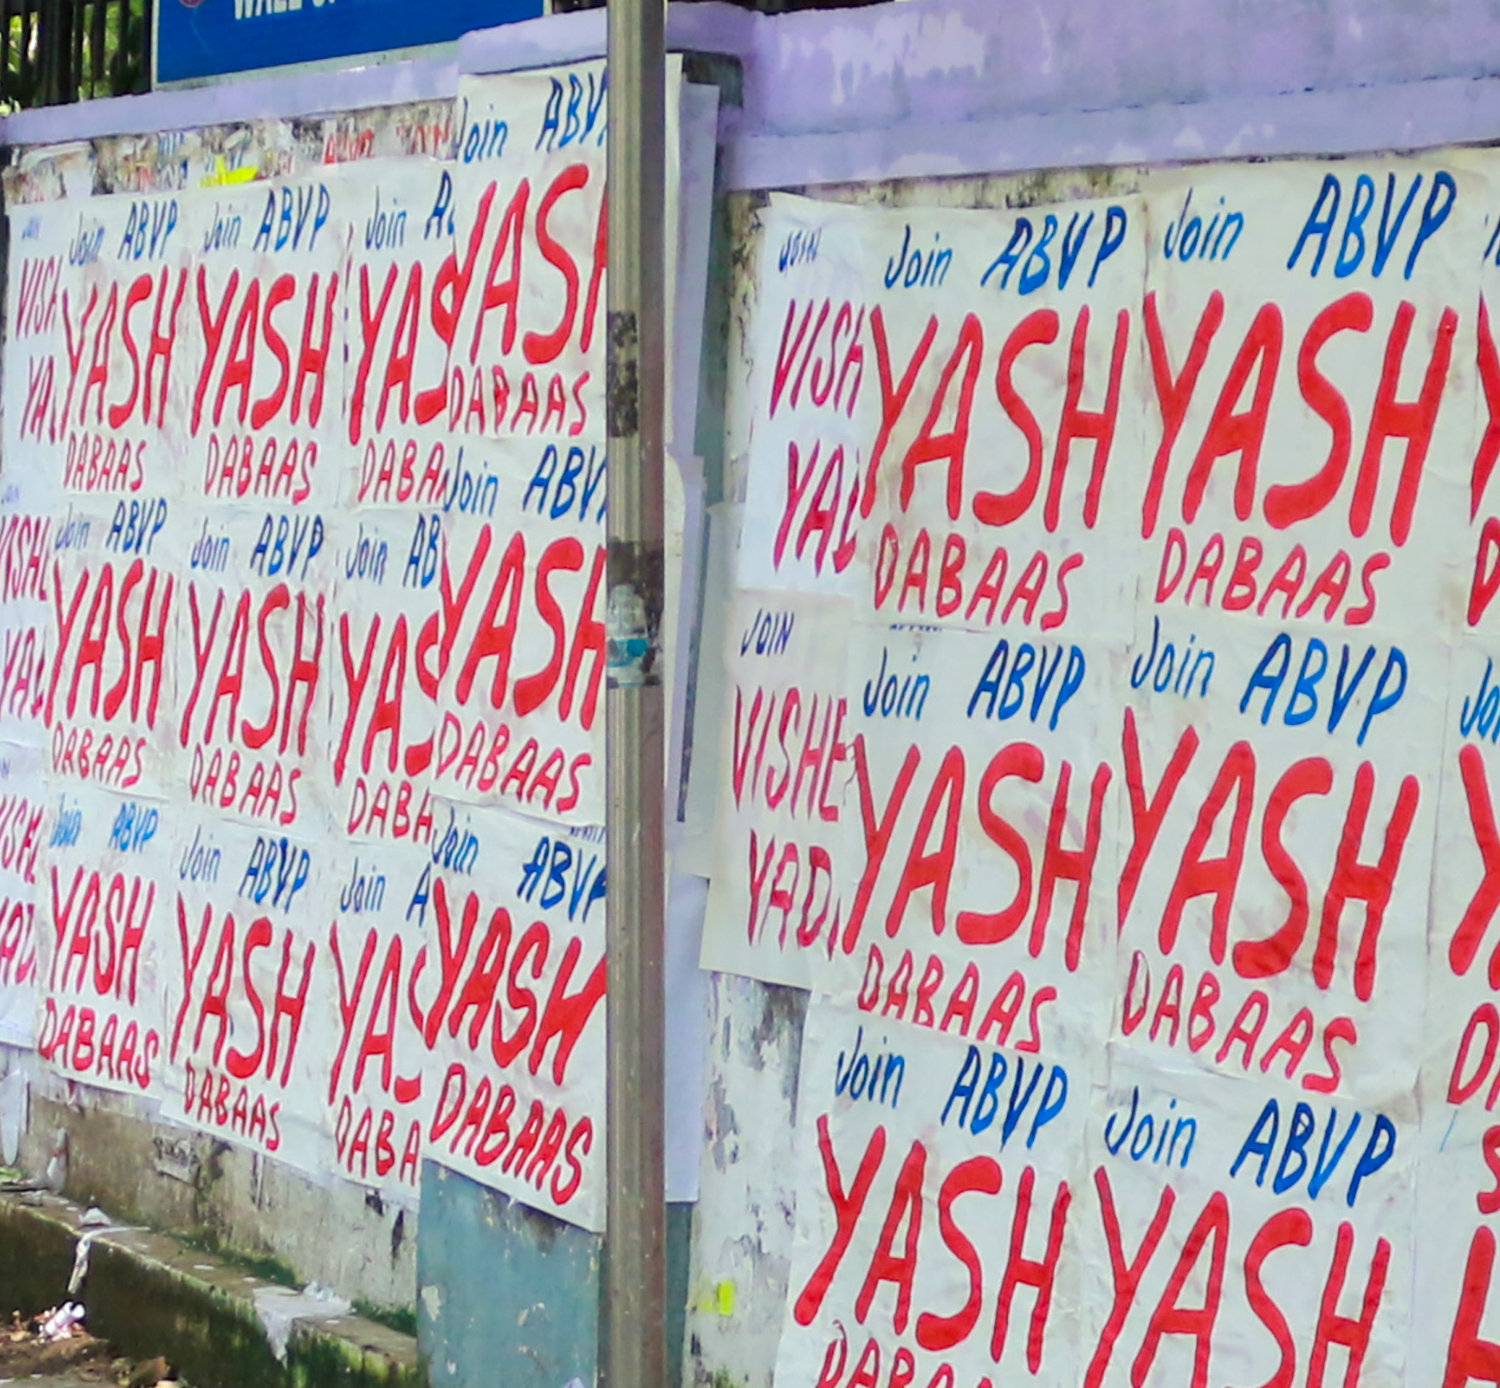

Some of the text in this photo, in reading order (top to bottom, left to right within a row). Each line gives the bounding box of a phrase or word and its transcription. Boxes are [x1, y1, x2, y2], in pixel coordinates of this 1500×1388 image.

[69, 201, 177, 266] Join ABVP
[204, 184, 329, 253] Join ABVP
[366, 190, 405, 248] Join
[884, 205, 1126, 295] Join ABVP
[1164, 170, 1457, 280] Join ABVP
[58, 260, 189, 442] YASH
[191, 263, 338, 437] YASH
[449, 363, 590, 437] DABAAS
[861, 303, 1130, 532] YASH
[1142, 290, 1458, 547] YASH
[62, 434, 145, 492] DABAAS
[206, 433, 316, 504] DABAAS
[443, 445, 499, 511] Join
[54, 499, 167, 554] Join ABVP
[190, 514, 324, 578] Join ABVP
[345, 524, 388, 585] Join
[873, 522, 1084, 631] DABAAS
[1154, 527, 1390, 626] DABAAS
[47, 557, 174, 729] YASH
[179, 581, 325, 757] YASH
[741, 608, 794, 657] JOIN
[1131, 614, 1407, 746] Join ABVP
[863, 638, 1086, 731] Join ABVP
[51, 720, 146, 788] DABAAS
[190, 743, 301, 825] DABAAS
[437, 710, 592, 816] DABAAS
[107, 802, 159, 853] ABVP
[179, 824, 311, 913] Join ABVP
[433, 808, 479, 875] Join
[842, 732, 1112, 973] YASH
[1118, 706, 1420, 1001] YASH
[341, 856, 386, 913] Join
[47, 865, 157, 1005] YASH
[425, 875, 606, 1085] YASH
[170, 891, 316, 1088] YASH
[857, 942, 1056, 1054] DABAAS
[1121, 950, 1356, 1094] DABAAS
[38, 997, 159, 1090] DABAAS
[835, 1026, 1069, 1151] Join ABVP
[183, 1070, 283, 1153] DABAAS
[429, 1061, 593, 1206] DABAAS
[1103, 1086, 1396, 1207] Join ABVP
[794, 1114, 1072, 1374] YASH
